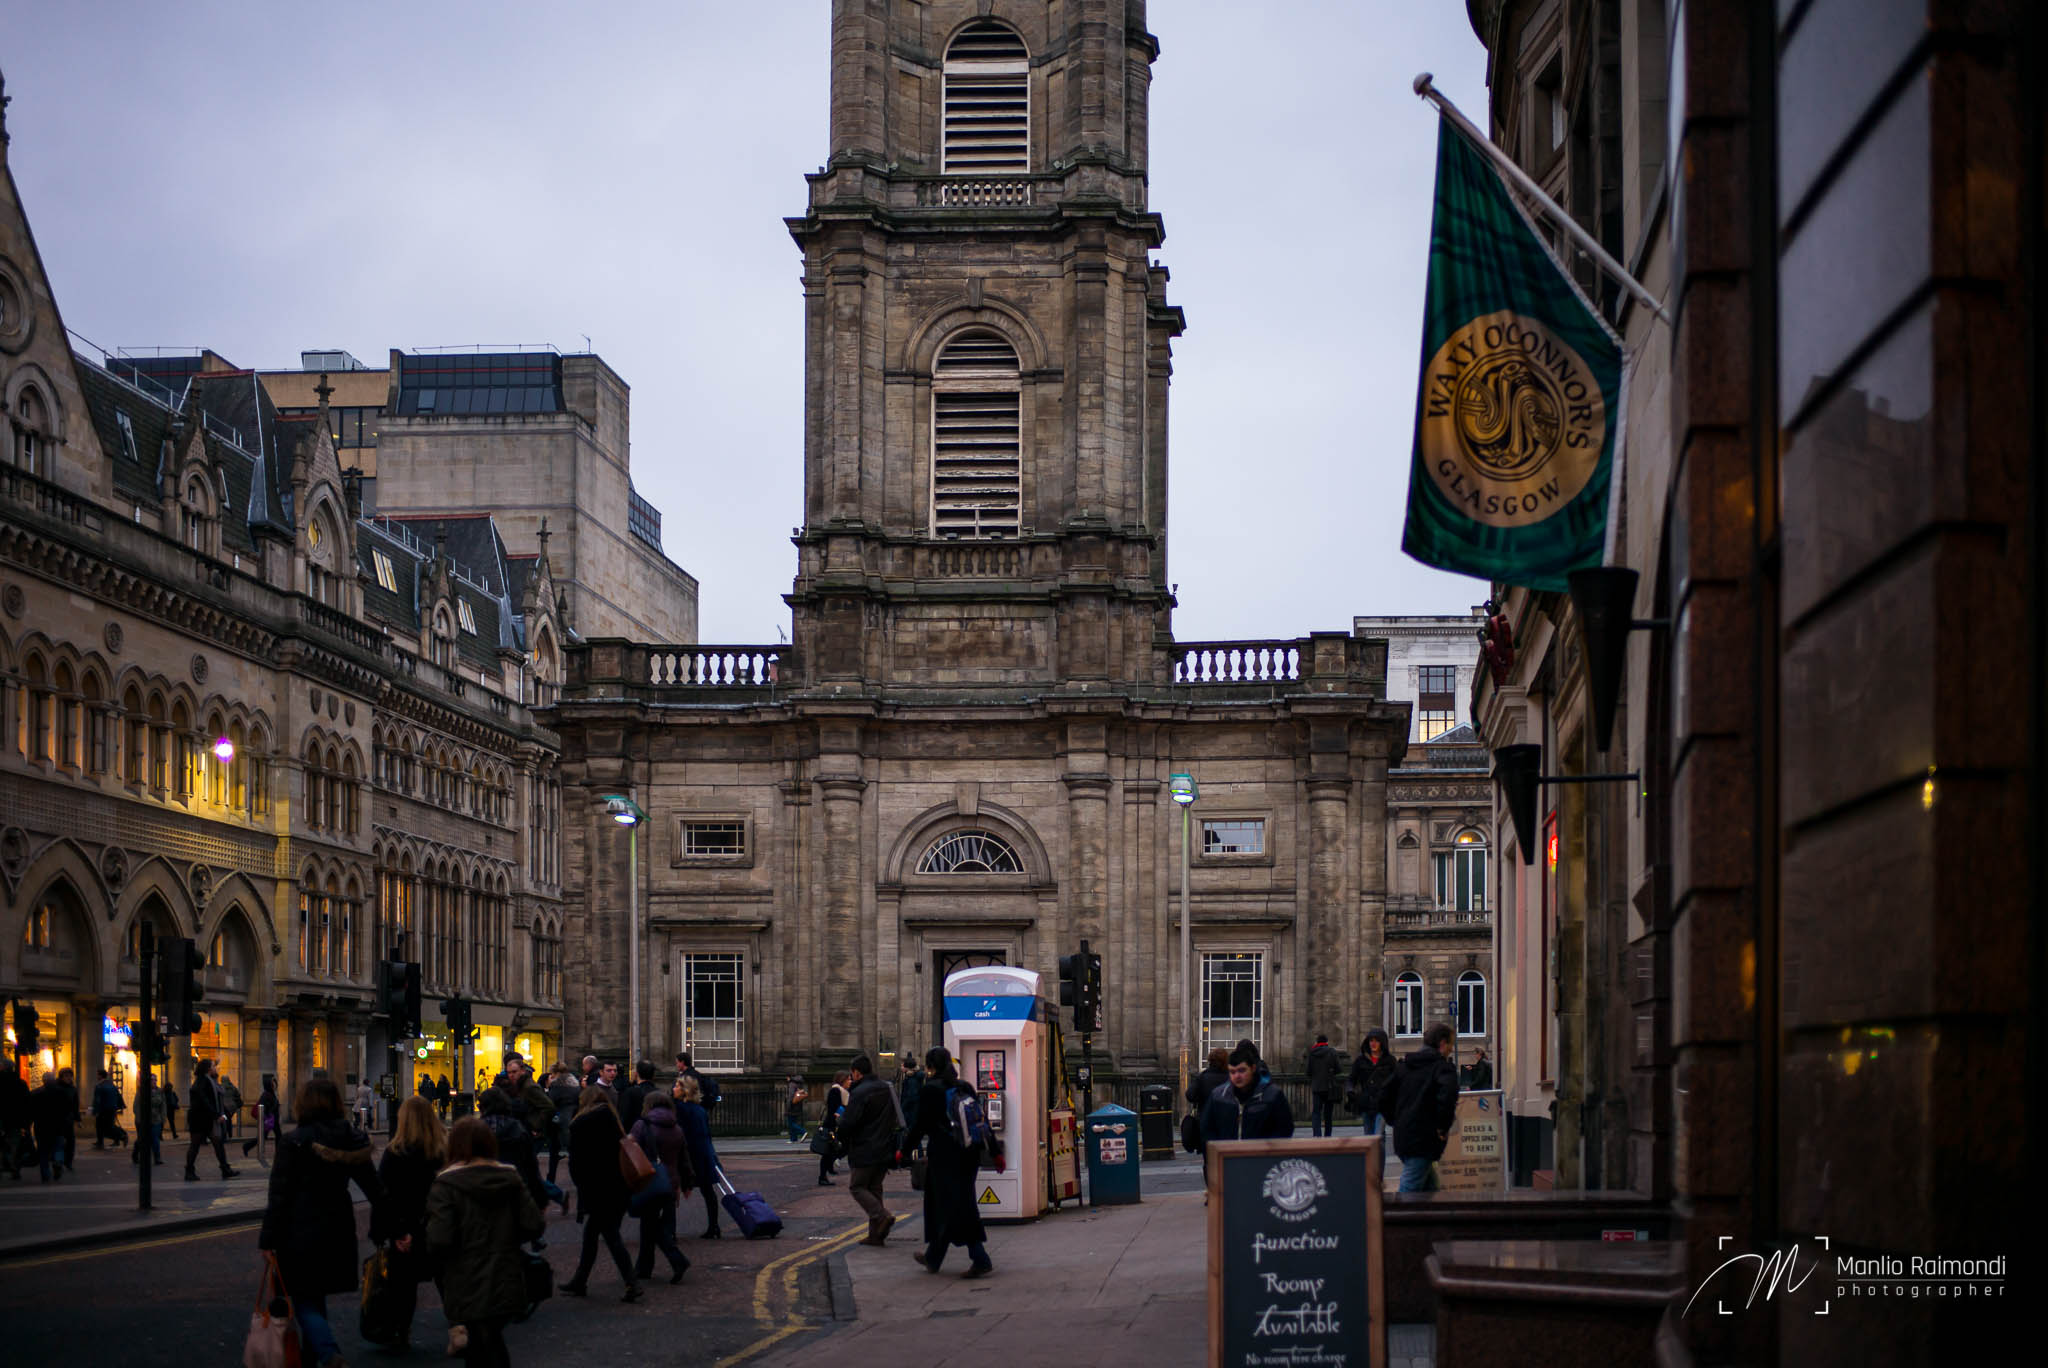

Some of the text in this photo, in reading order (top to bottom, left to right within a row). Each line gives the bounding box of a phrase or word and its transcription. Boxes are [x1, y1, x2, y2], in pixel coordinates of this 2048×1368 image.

[1428, 322, 1593, 449] WAXY O'CONNOR'S
[1438, 459, 1560, 516] GLASGOW
[1477, 1144, 1494, 1152] RENT
[1263, 1165, 1280, 1198] WAXY
[1270, 1206, 1317, 1222] GLASGOW
[1259, 1272, 1325, 1300] Rooms
[1245, 1353, 1261, 1366] No
